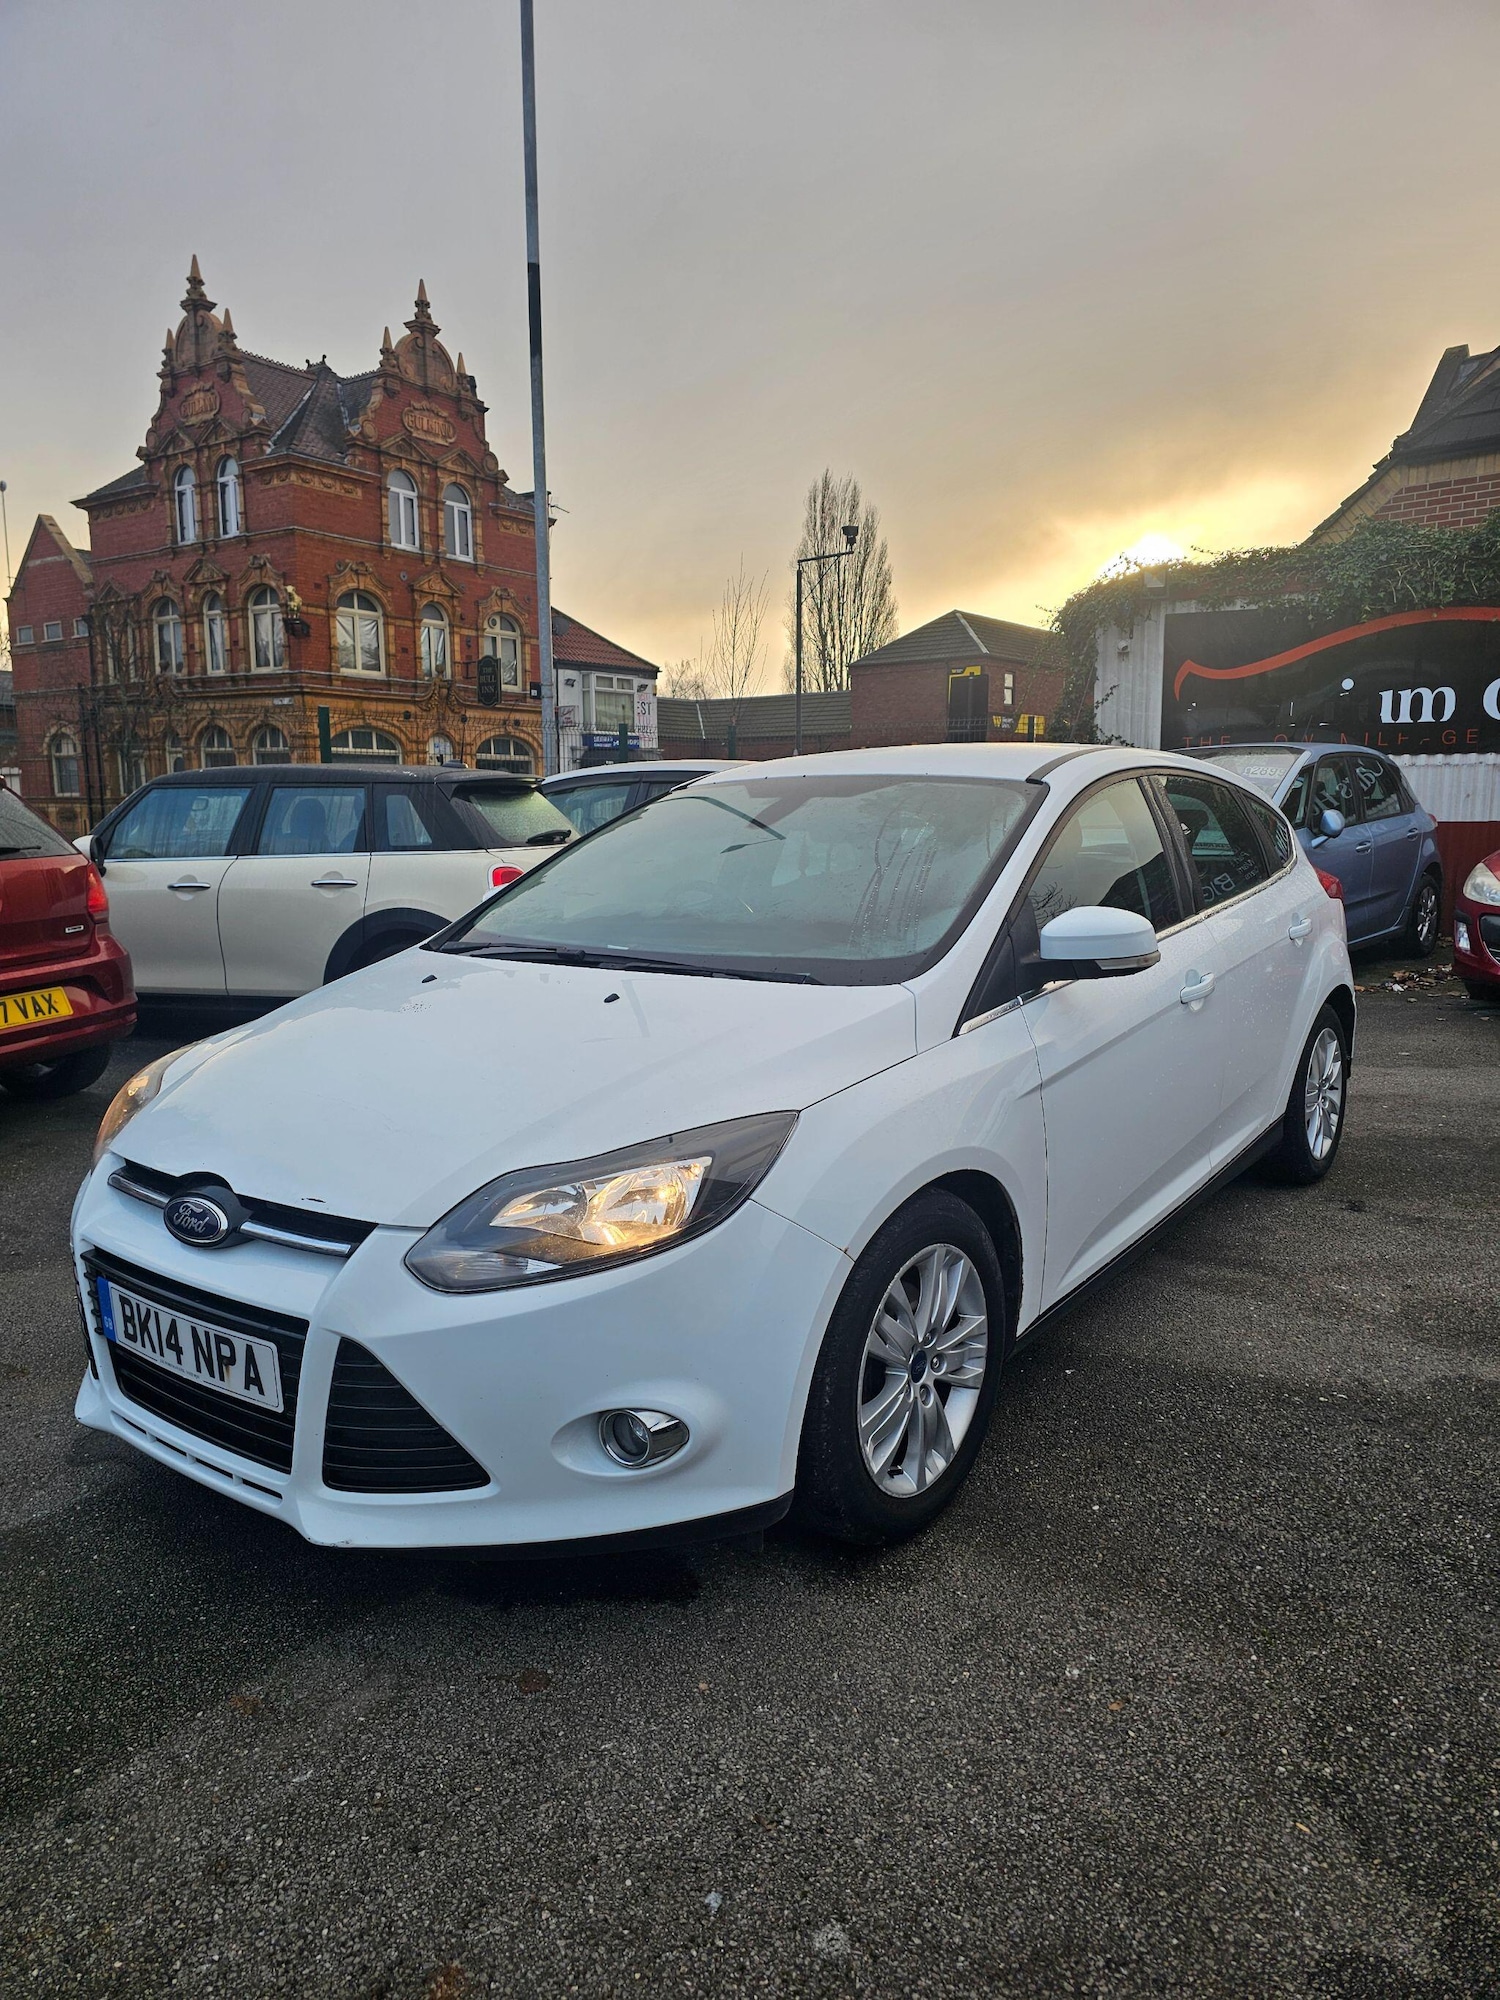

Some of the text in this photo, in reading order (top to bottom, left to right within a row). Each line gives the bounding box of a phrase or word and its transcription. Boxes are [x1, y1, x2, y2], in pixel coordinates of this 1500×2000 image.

[479, 675, 496, 683] BULL
[481, 685, 495, 693] INN
[14, 993, 59, 1019] VAX
[174, 1203, 210, 1233] Ford
[103, 1316, 113, 1331] GB
[119, 1293, 265, 1397] BK14 NPA
